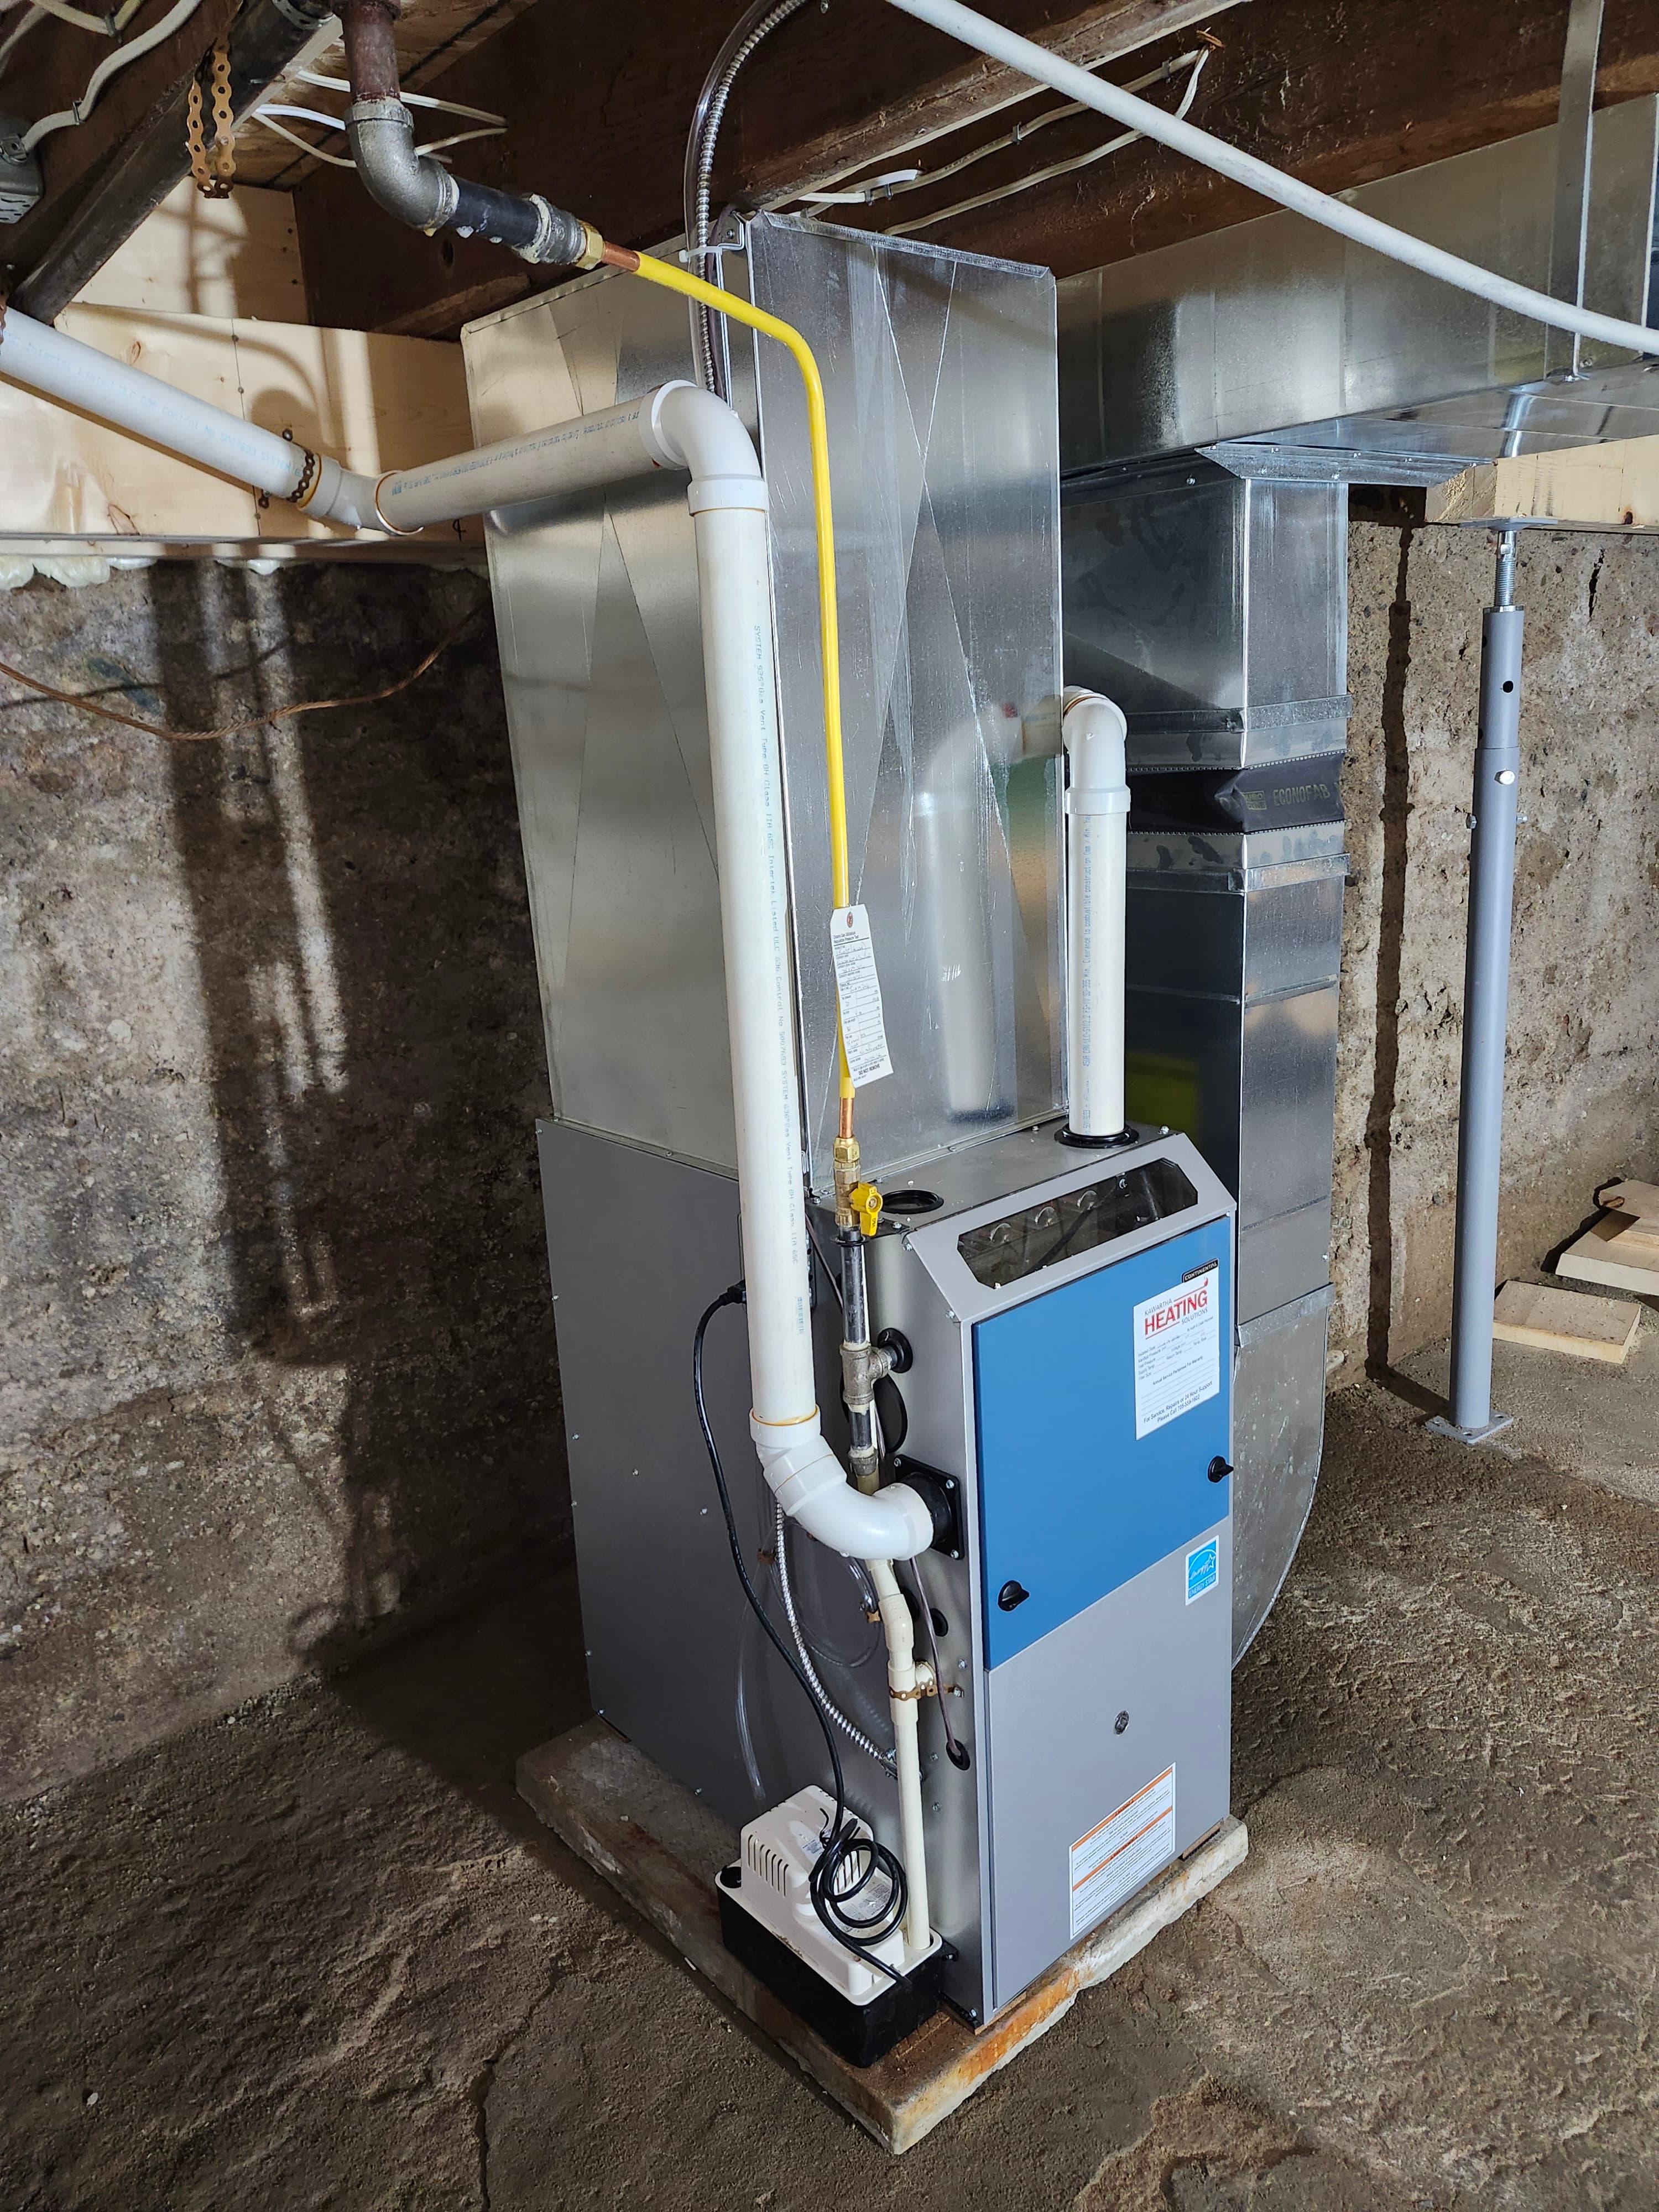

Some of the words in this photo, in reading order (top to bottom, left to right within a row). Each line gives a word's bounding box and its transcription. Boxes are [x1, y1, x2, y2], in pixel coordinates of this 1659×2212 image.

[1273, 784, 1330, 806] ECONOFAB
[753, 625, 762, 659] SYSTEM
[768, 854, 776, 895] Intertek
[778, 1016, 784, 1026] No
[1082, 937, 1091, 963] Clearance
[1185, 1261, 1218, 1281] CONTINENTAL
[1144, 1298, 1172, 1316] KAWARTHA
[1145, 1289, 1208, 1335] HEATING
[1181, 1307, 1208, 1325] SOLUTIONS
[1152, 1376, 1162, 1385] Annual
[1162, 1372, 1173, 1380] Service
[1166, 1399, 1180, 1411] Repairs
[1190, 1389, 1198, 1397] Hour
[1198, 1381, 1212, 1392] Support
[1157, 1413, 1170, 1423] Please
